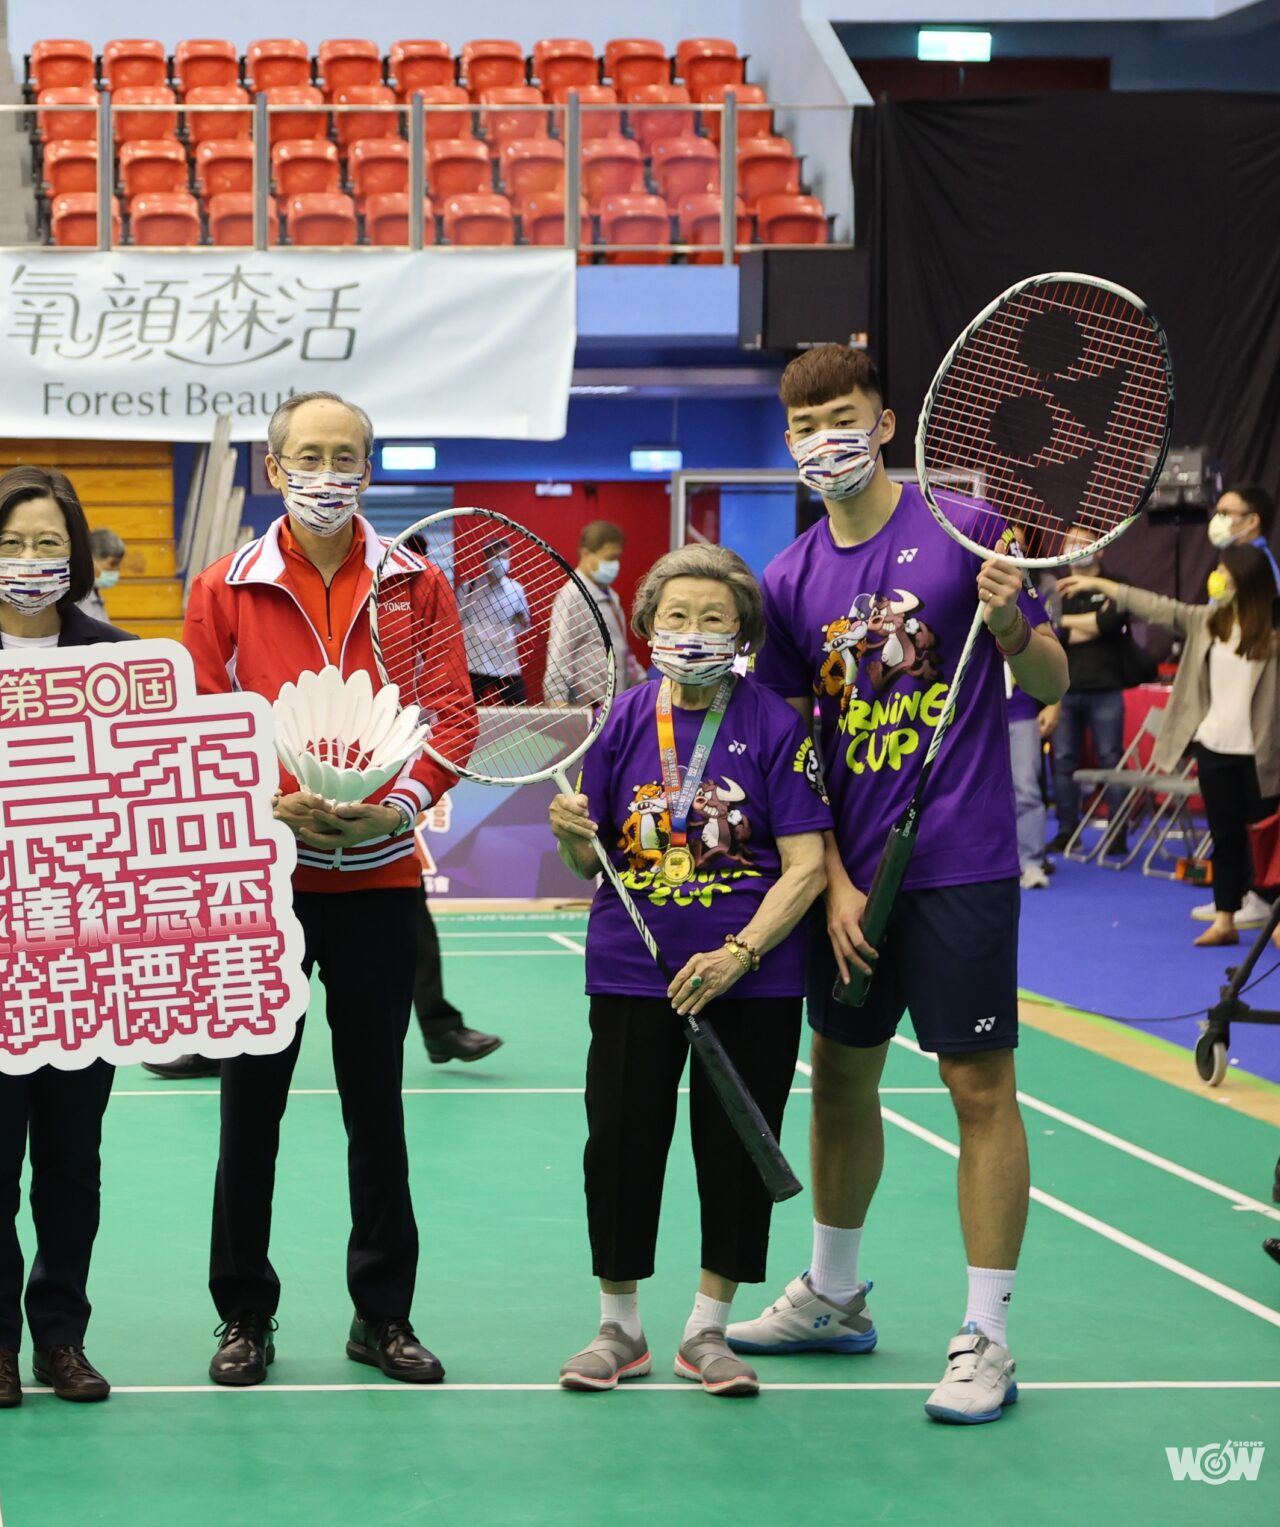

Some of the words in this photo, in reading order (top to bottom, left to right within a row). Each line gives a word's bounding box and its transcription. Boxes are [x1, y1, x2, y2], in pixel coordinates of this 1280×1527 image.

[43, 383, 169, 417] Forest
[382, 600, 411, 612] YONEX
[846, 727, 919, 775] CUP
